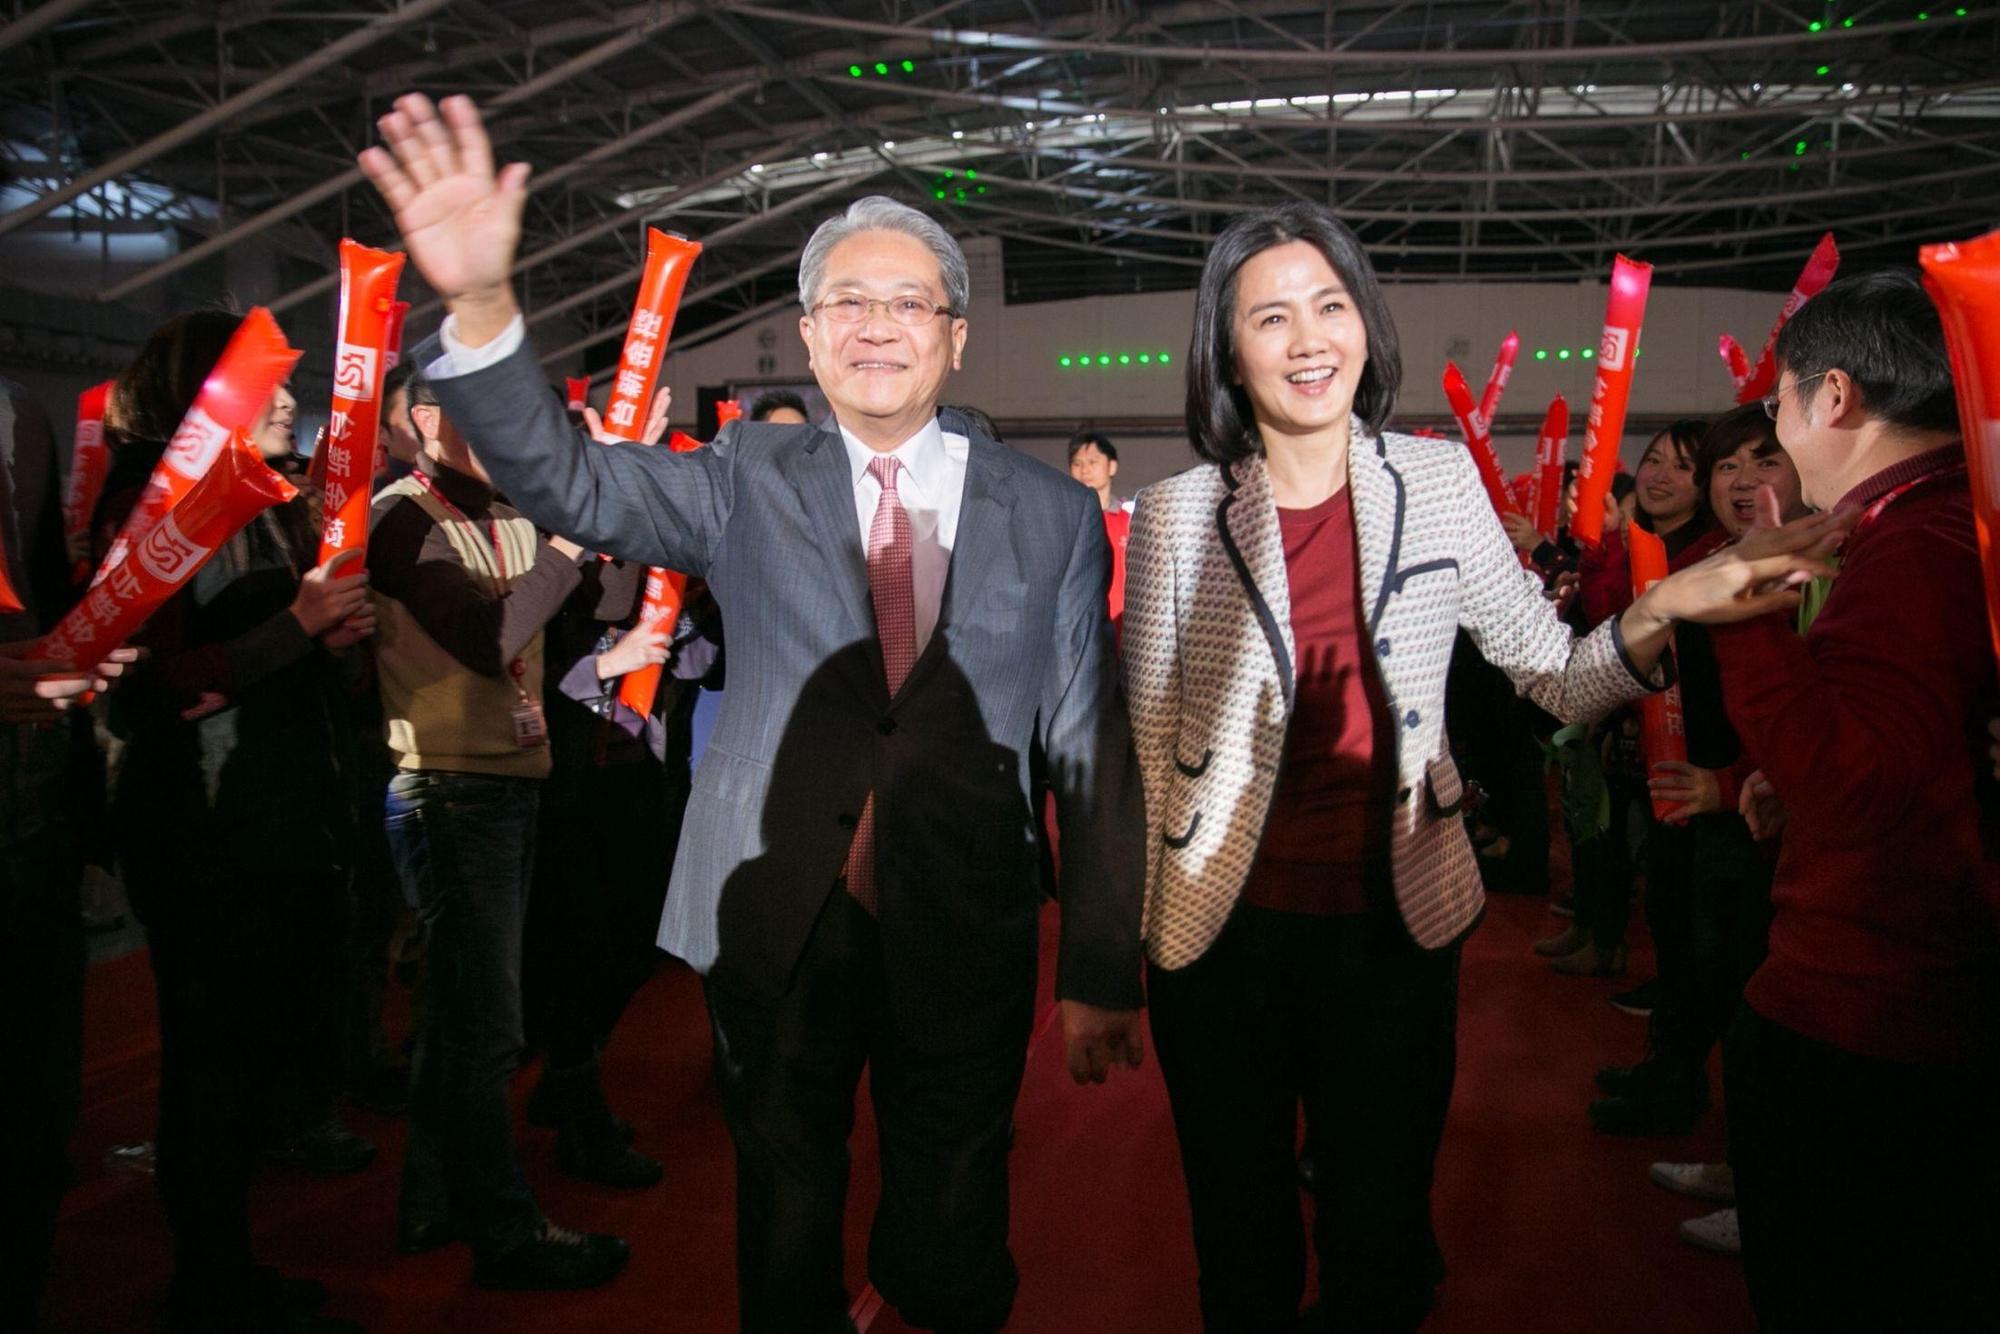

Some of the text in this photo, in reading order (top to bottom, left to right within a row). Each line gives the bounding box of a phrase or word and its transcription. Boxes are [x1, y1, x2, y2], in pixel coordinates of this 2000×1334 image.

[608, 308, 663, 427] 台新金控
[323, 411, 354, 548] 台新金控
